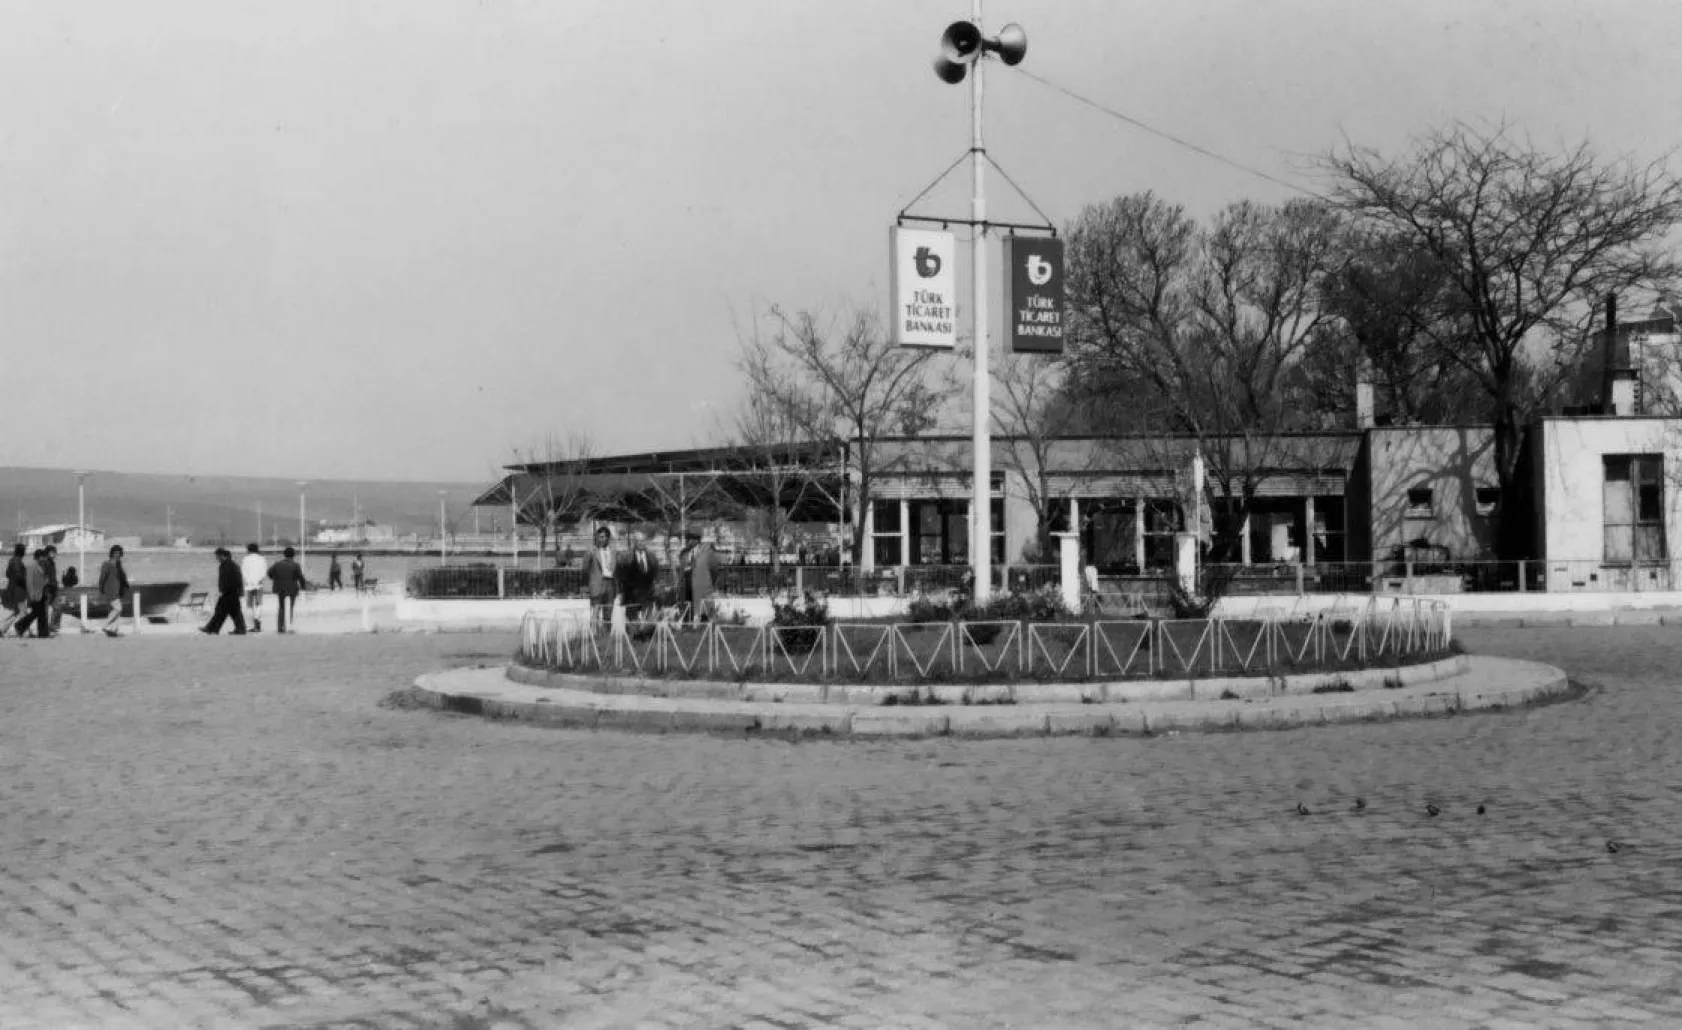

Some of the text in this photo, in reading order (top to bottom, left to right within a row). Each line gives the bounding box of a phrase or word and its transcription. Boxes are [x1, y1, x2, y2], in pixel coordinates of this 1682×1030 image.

[914, 289, 943, 304] TÜRK
[1026, 294, 1054, 308] TÜRK
[905, 319, 952, 334] BANKASI
[1017, 323, 1062, 337] BANKASI
